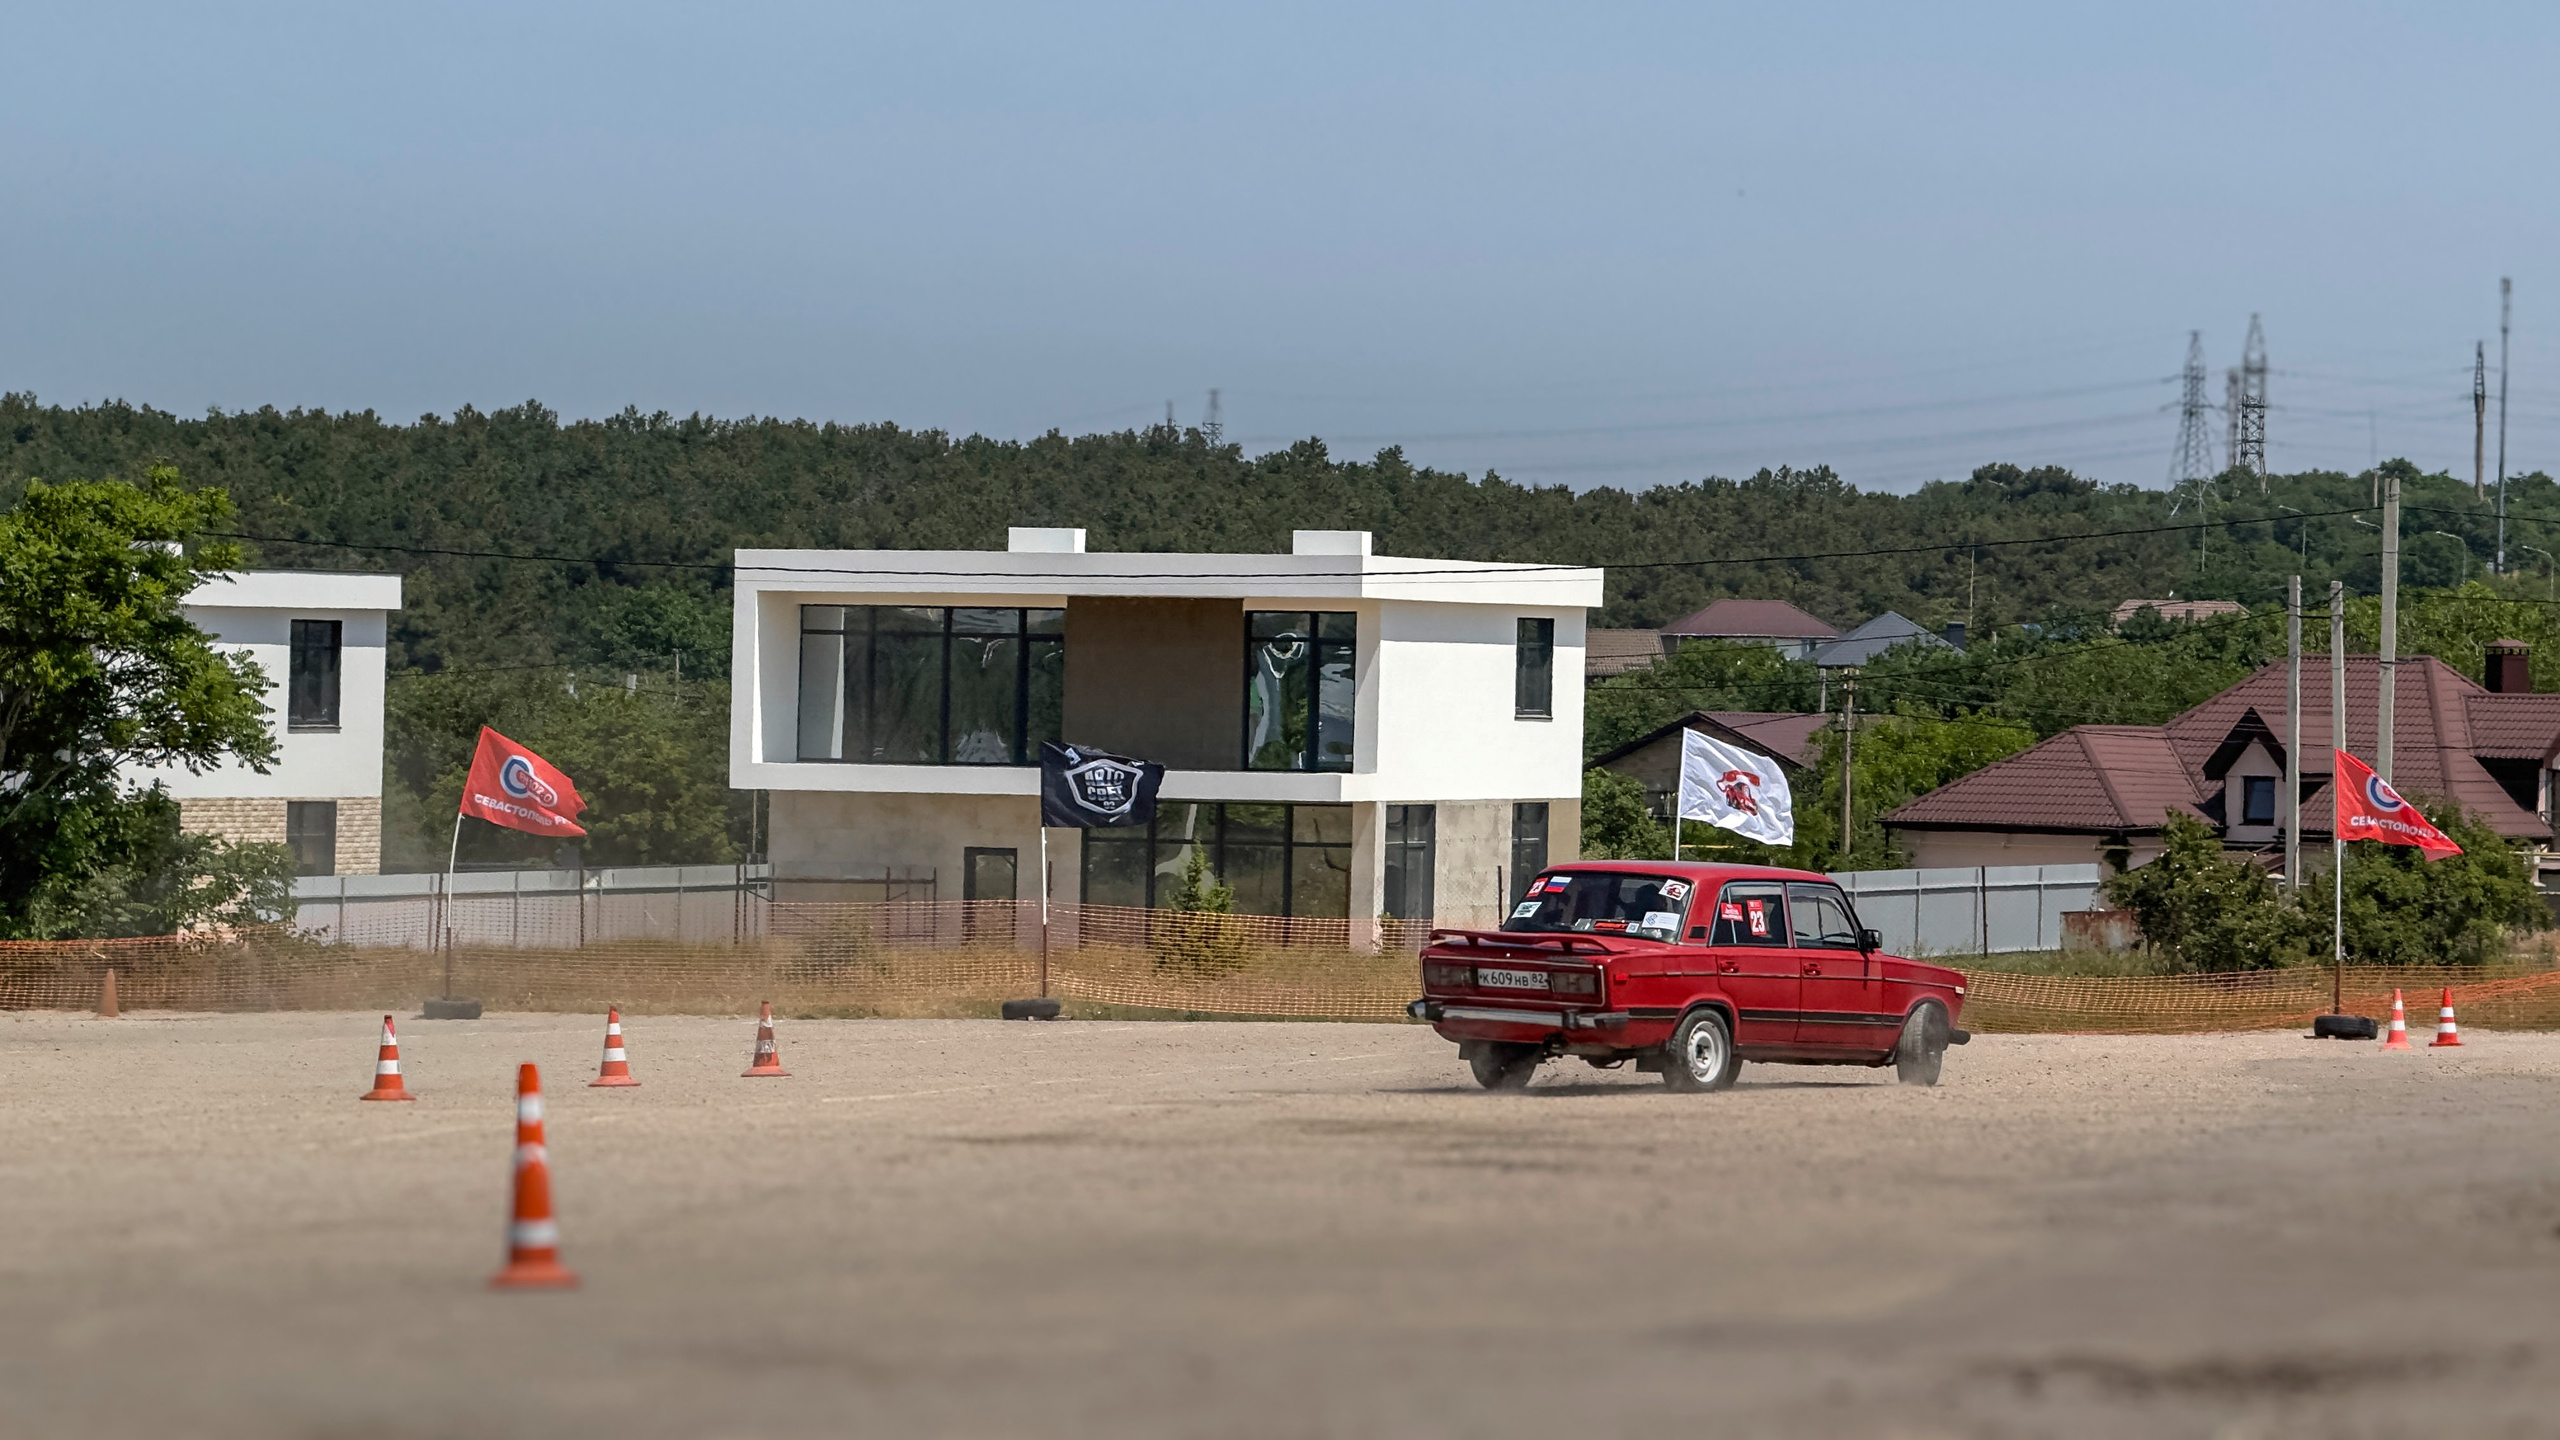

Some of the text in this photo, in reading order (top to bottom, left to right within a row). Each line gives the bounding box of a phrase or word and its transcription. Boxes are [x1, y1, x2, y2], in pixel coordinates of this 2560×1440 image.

[474, 793, 552, 826] СЕВАСТОПЬ
[1529, 881, 1546, 894] 23
[1750, 910, 1766, 933] 23
